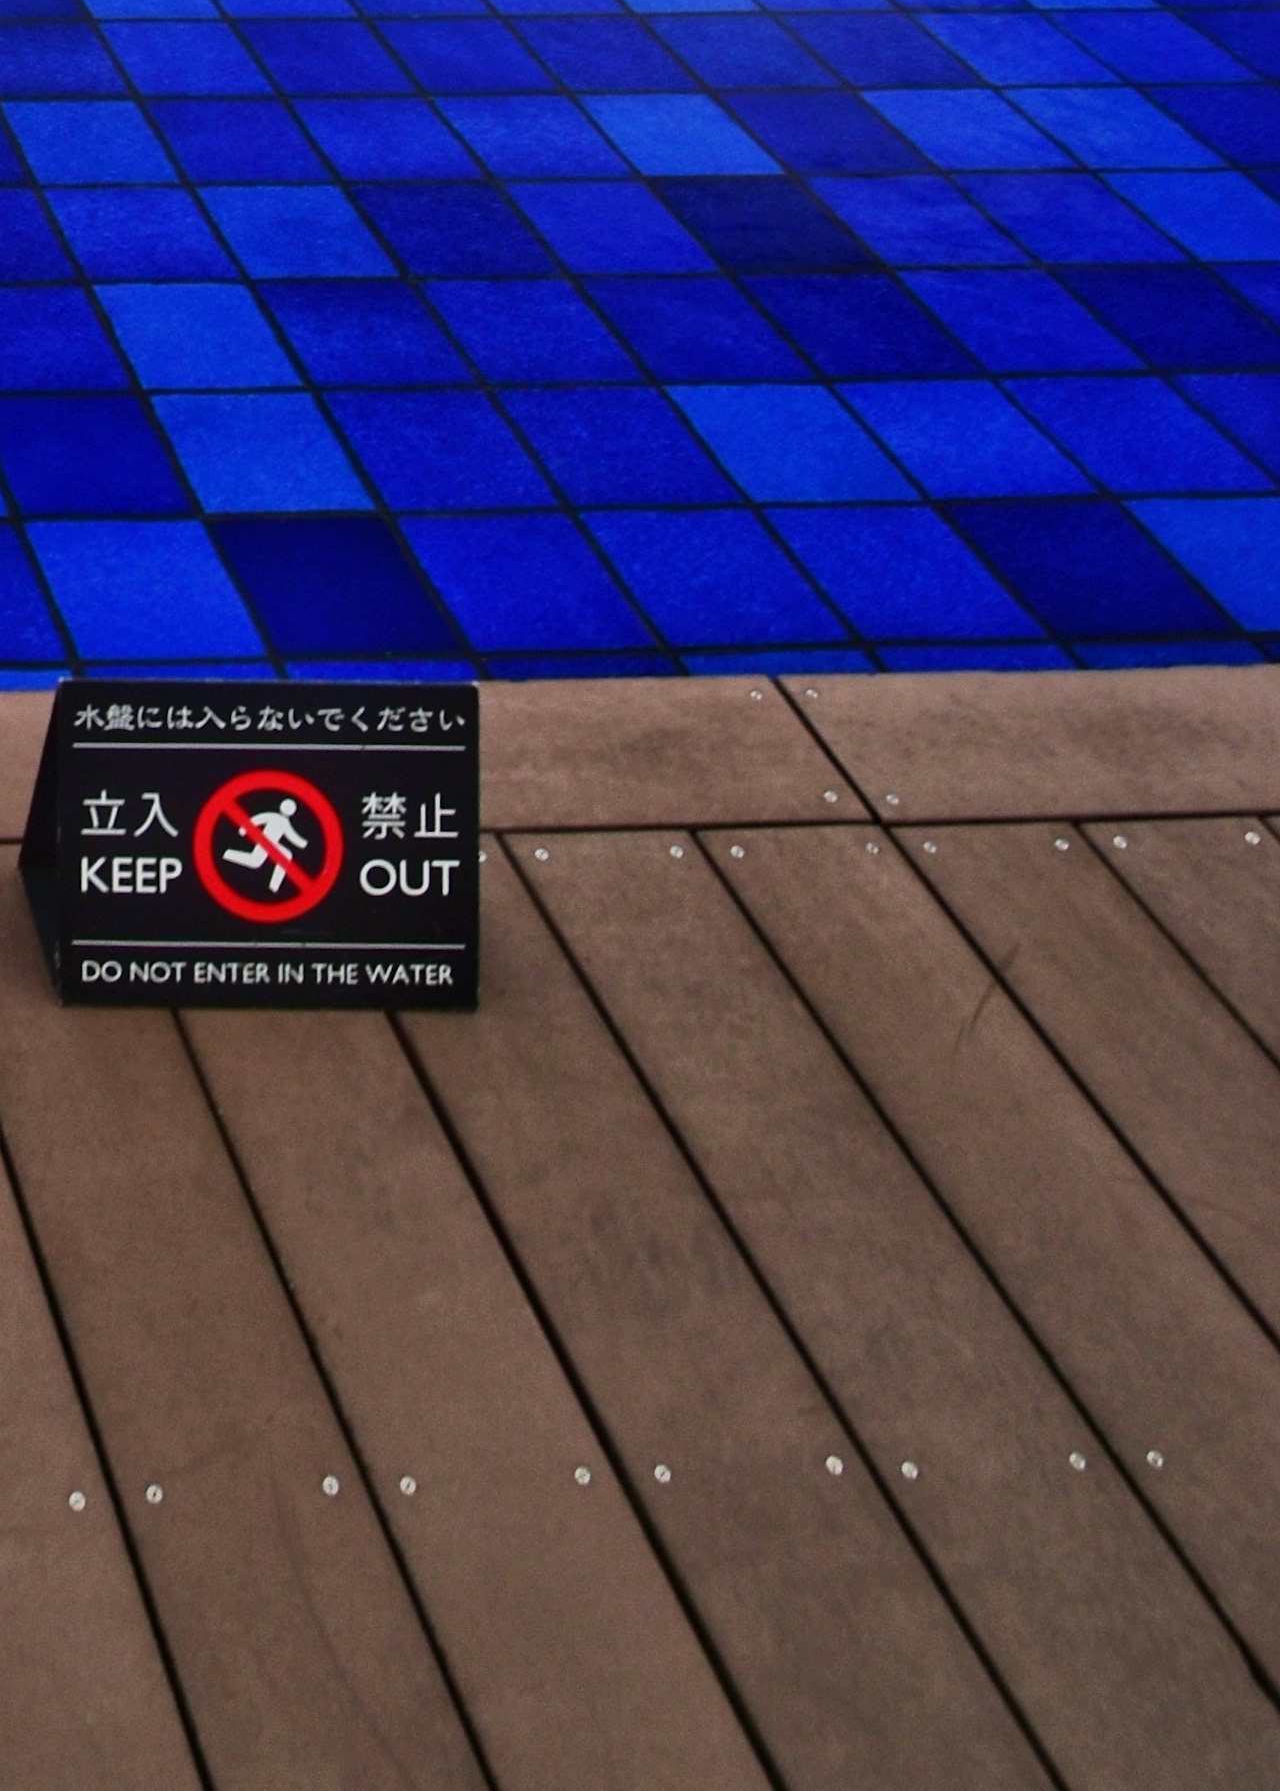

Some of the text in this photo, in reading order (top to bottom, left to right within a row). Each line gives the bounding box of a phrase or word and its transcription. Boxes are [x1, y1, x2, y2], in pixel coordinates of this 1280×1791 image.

[73, 703, 466, 733] 水盤には入らないでください
[80, 789, 459, 840] 立入 禁止
[80, 856, 460, 897] KEEP OUT
[81, 960, 453, 986] DO NOT ENTER IN THE WATER
